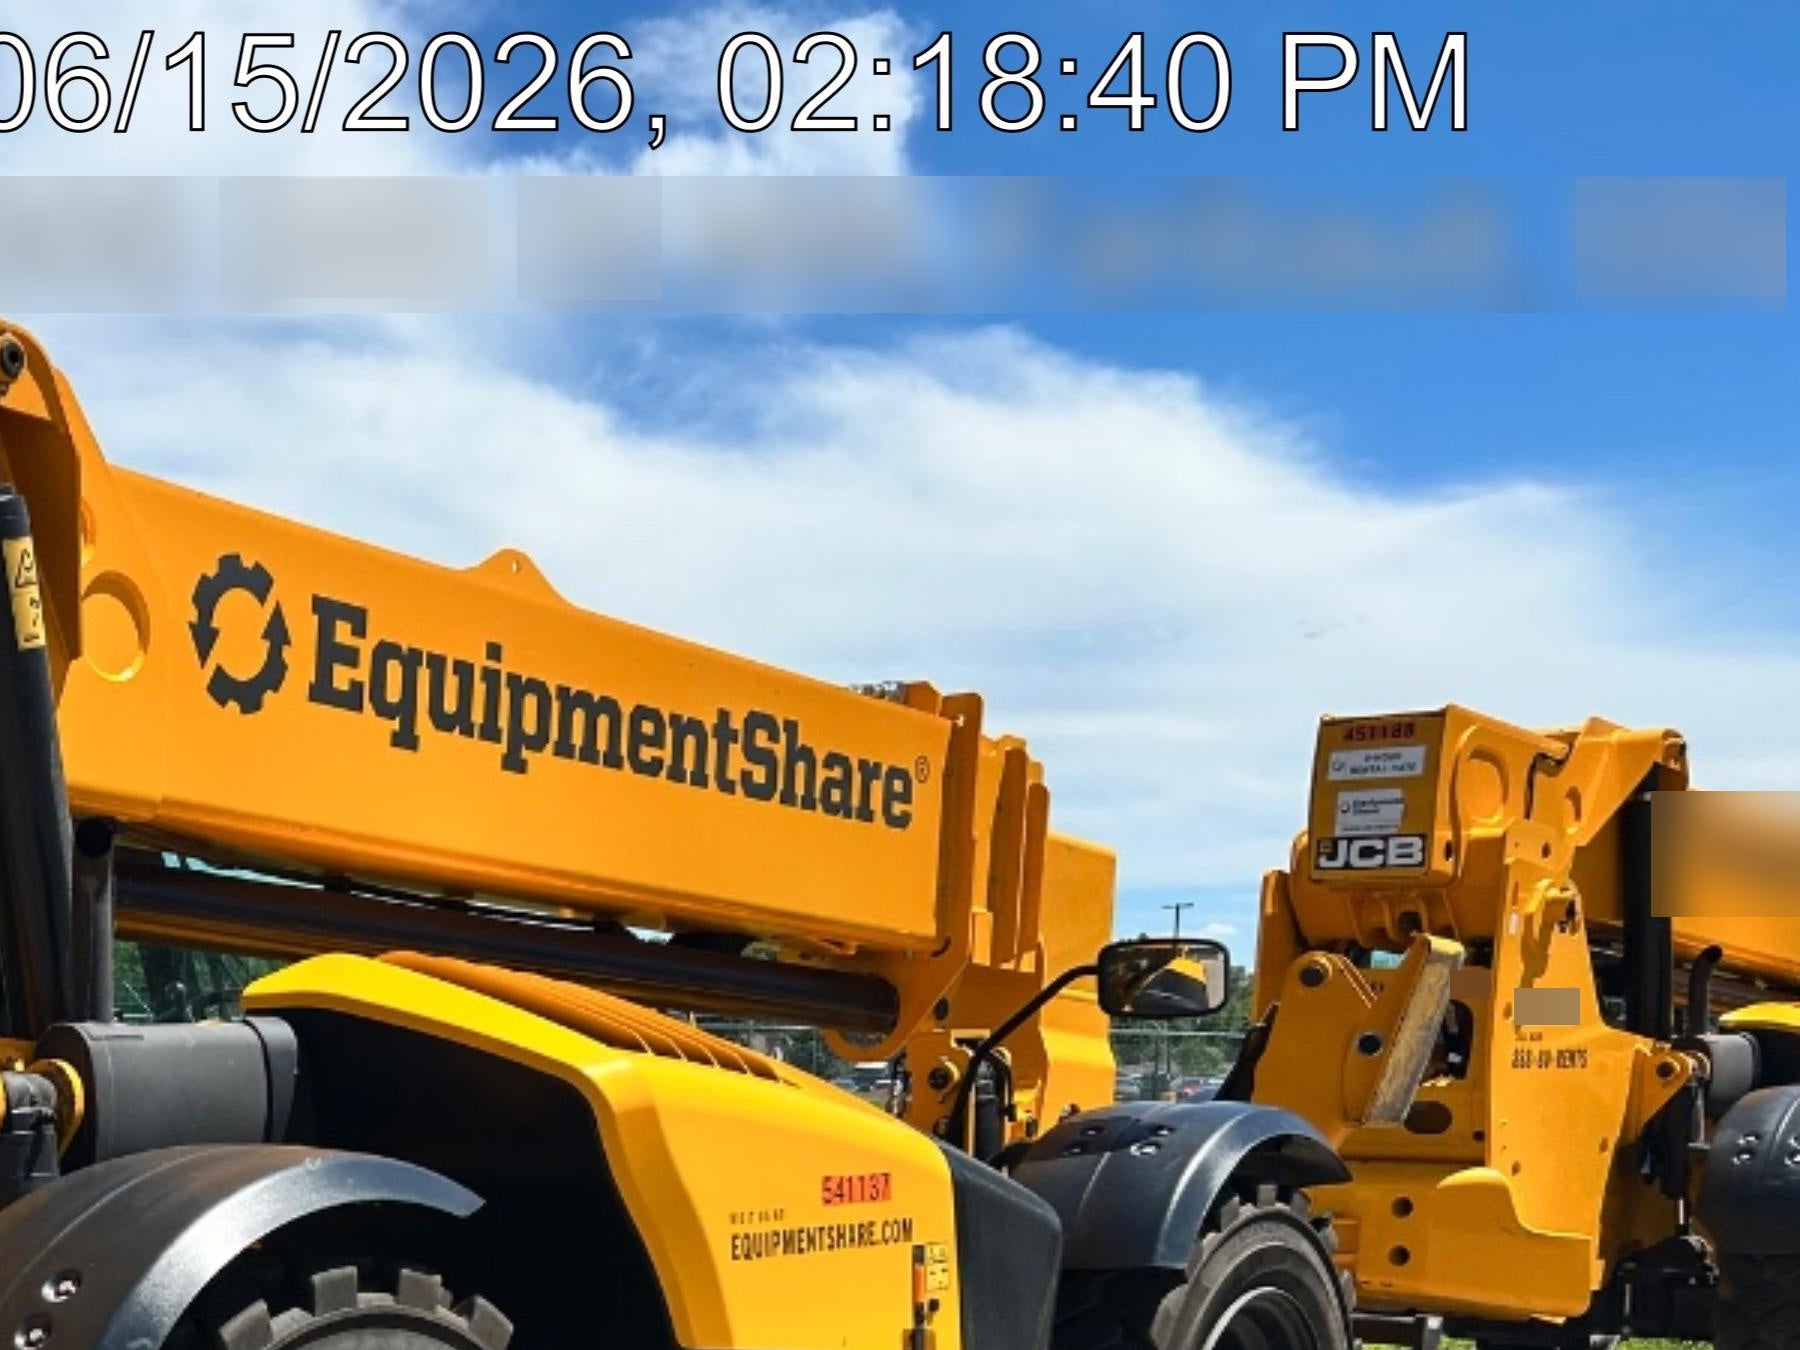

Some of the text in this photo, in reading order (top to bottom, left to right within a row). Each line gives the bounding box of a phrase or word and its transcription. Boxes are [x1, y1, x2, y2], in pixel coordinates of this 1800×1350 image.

[307, 593, 913, 829] EquipmentShare
[1318, 836, 1424, 869] JCB
[822, 1172, 892, 1206] 541137
[731, 1216, 913, 1262] EQUIPMENTSHARE.COM
